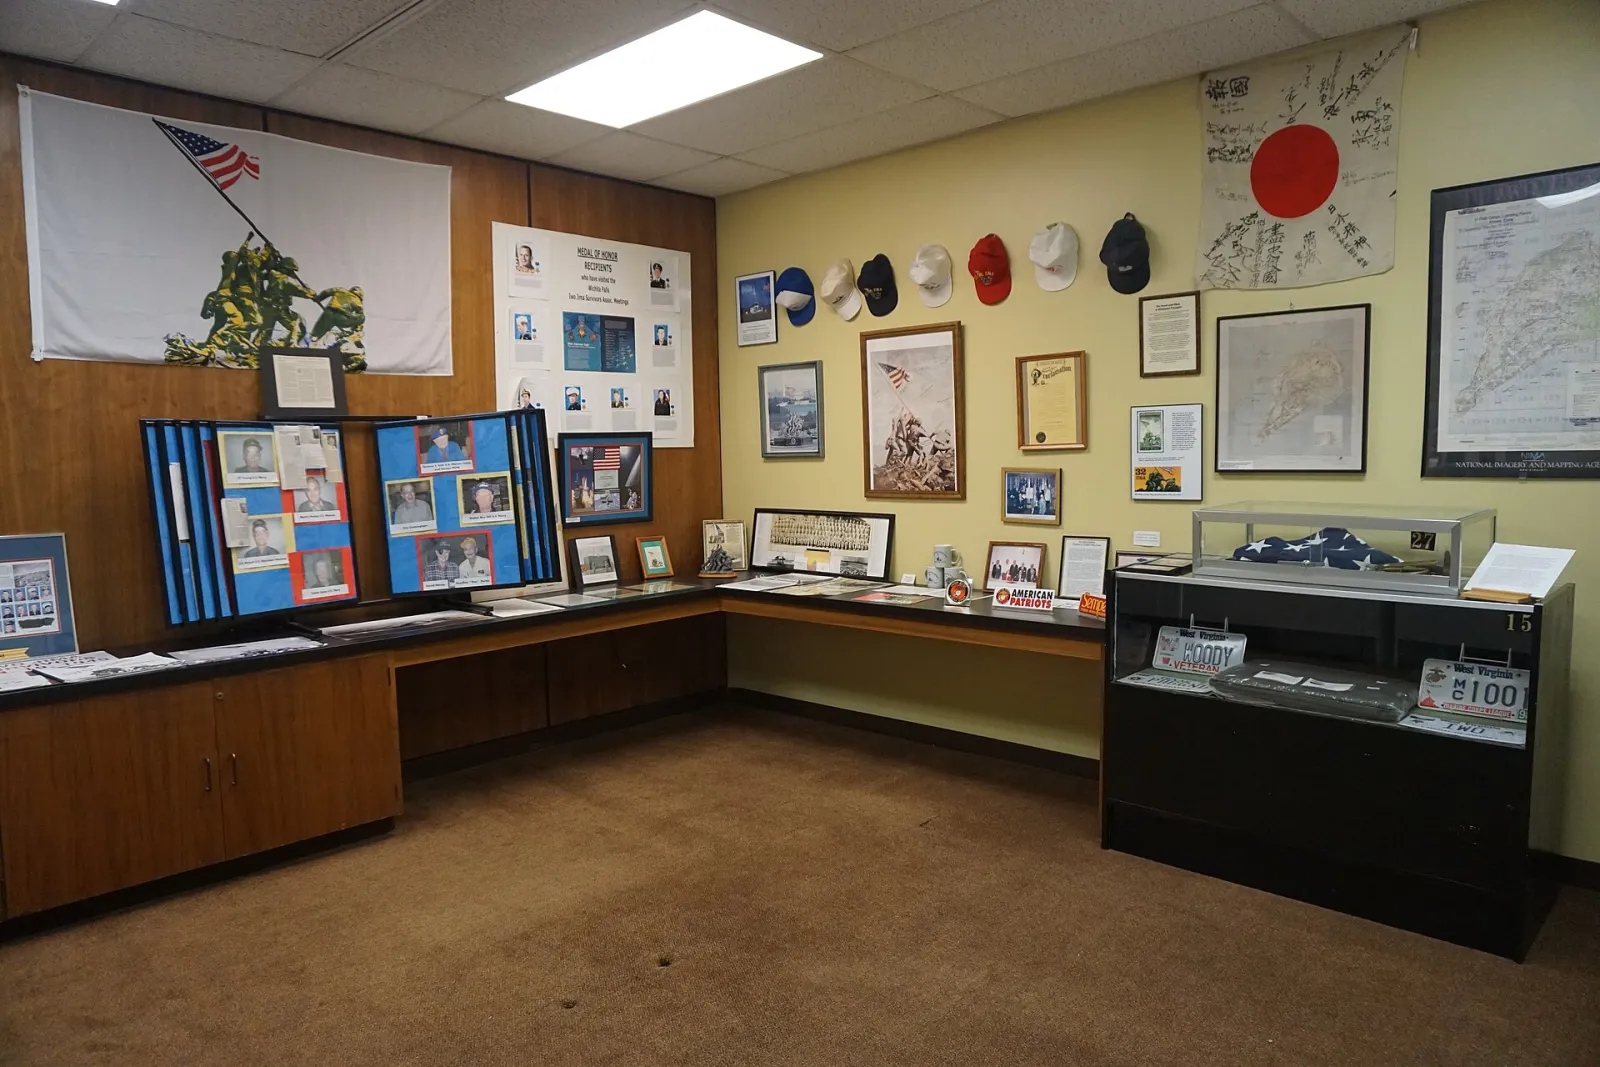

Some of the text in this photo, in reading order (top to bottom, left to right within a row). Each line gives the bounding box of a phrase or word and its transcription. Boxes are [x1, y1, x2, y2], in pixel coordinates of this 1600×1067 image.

[577, 247, 618, 260] MEDAL OF HONOR
[584, 261, 612, 273] RECIPIENTS
[1135, 468, 1147, 476] 32
[1411, 532, 1435, 549] 27
[1011, 589, 1053, 600] AMERICAN
[1010, 598, 1052, 609] PATRIOTS
[1507, 613, 1531, 631] 15
[1180, 629, 1226, 641] West Virginia
[1183, 643, 1234, 667] WOODY
[1174, 660, 1220, 673] VETERAN
[1453, 663, 1513, 680] West Virginia
